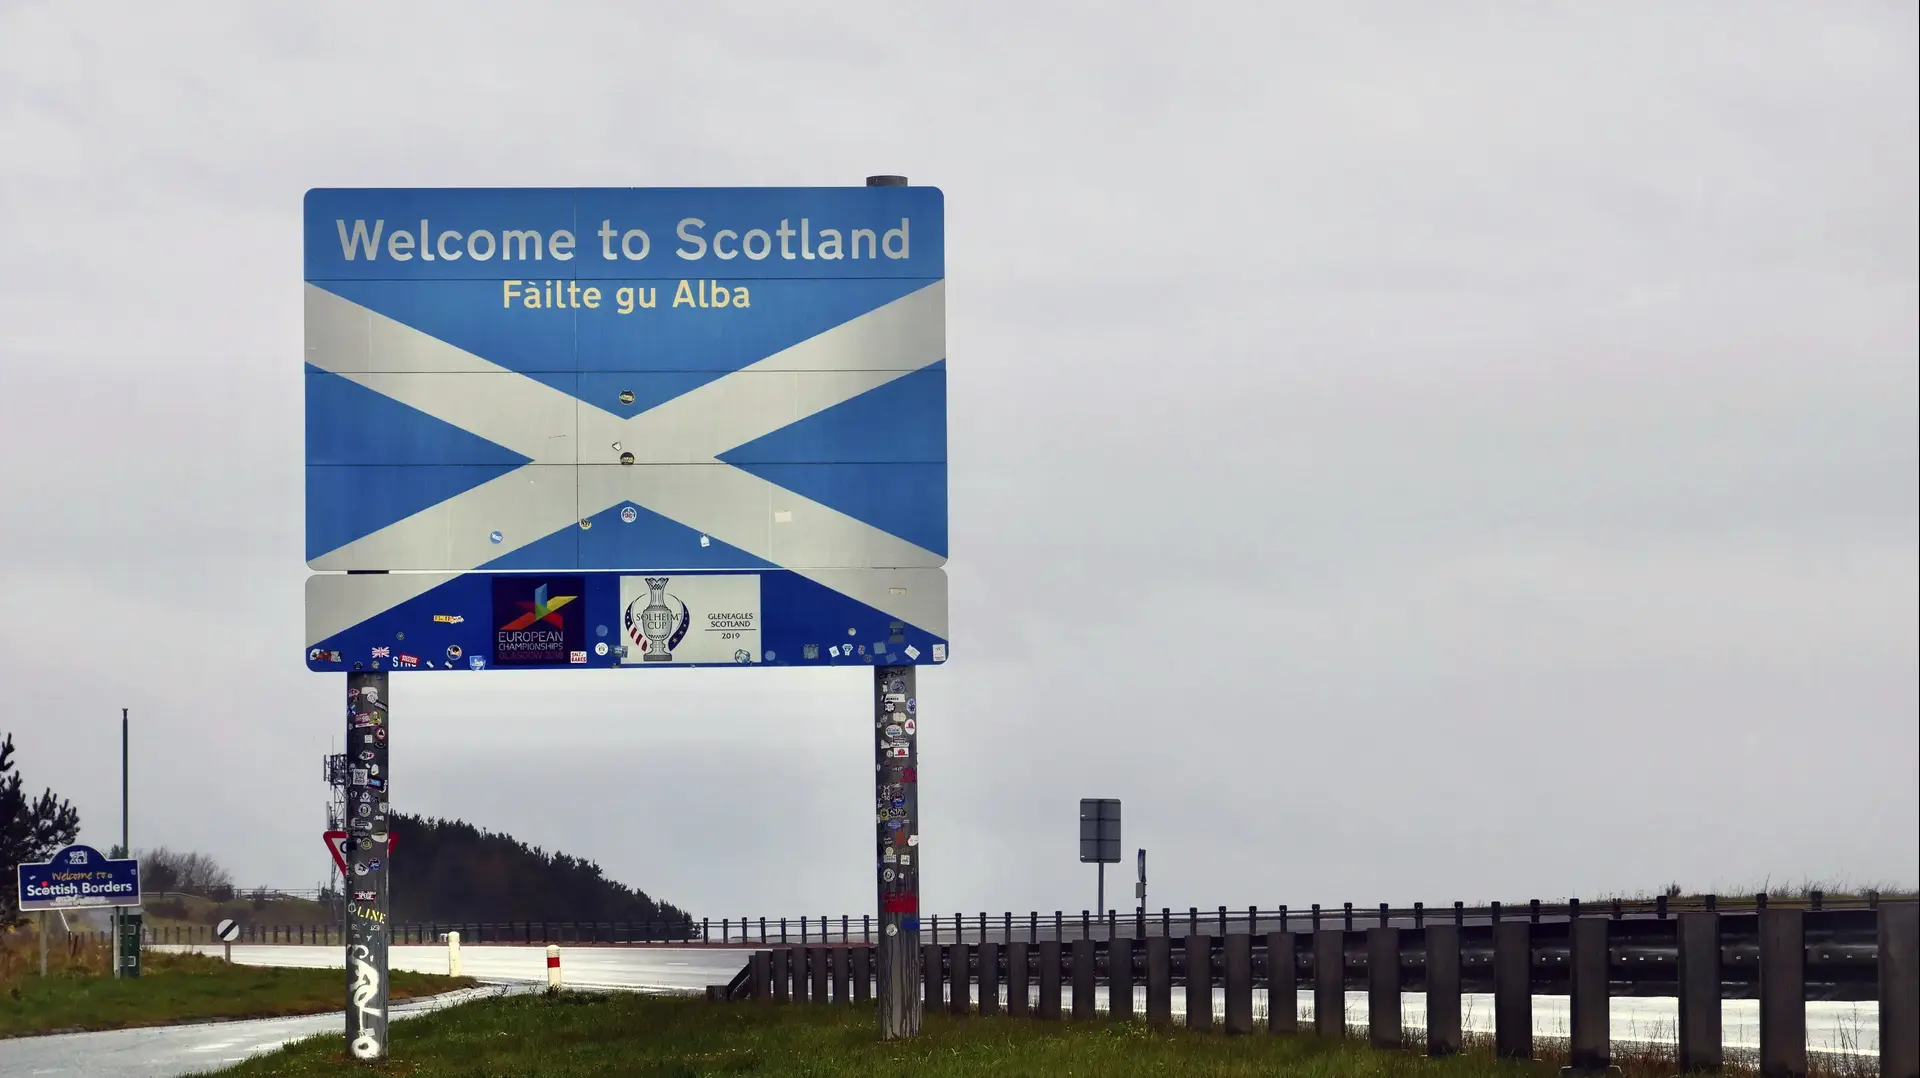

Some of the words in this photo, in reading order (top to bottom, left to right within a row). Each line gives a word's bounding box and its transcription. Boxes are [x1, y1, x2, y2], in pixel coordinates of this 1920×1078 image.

[336, 218, 576, 262] Welcome
[597, 218, 651, 262] to
[675, 217, 912, 262] Scotland
[502, 279, 601, 309] Fàilte
[615, 286, 658, 314] gu
[672, 279, 751, 309] Alba
[635, 612, 679, 622] SOLHEIM
[707, 612, 754, 620] GLENEAGLES
[647, 621, 667, 630] CUP
[710, 620, 751, 628] SCOTLAND
[498, 631, 564, 643] EUROPEAN
[721, 632, 741, 640] 2019
[498, 642, 564, 651] CHAMPIONSHIPS
[51, 868, 93, 881] Welcome
[26, 882, 78, 897] Scottish
[81, 880, 133, 894] Borders
